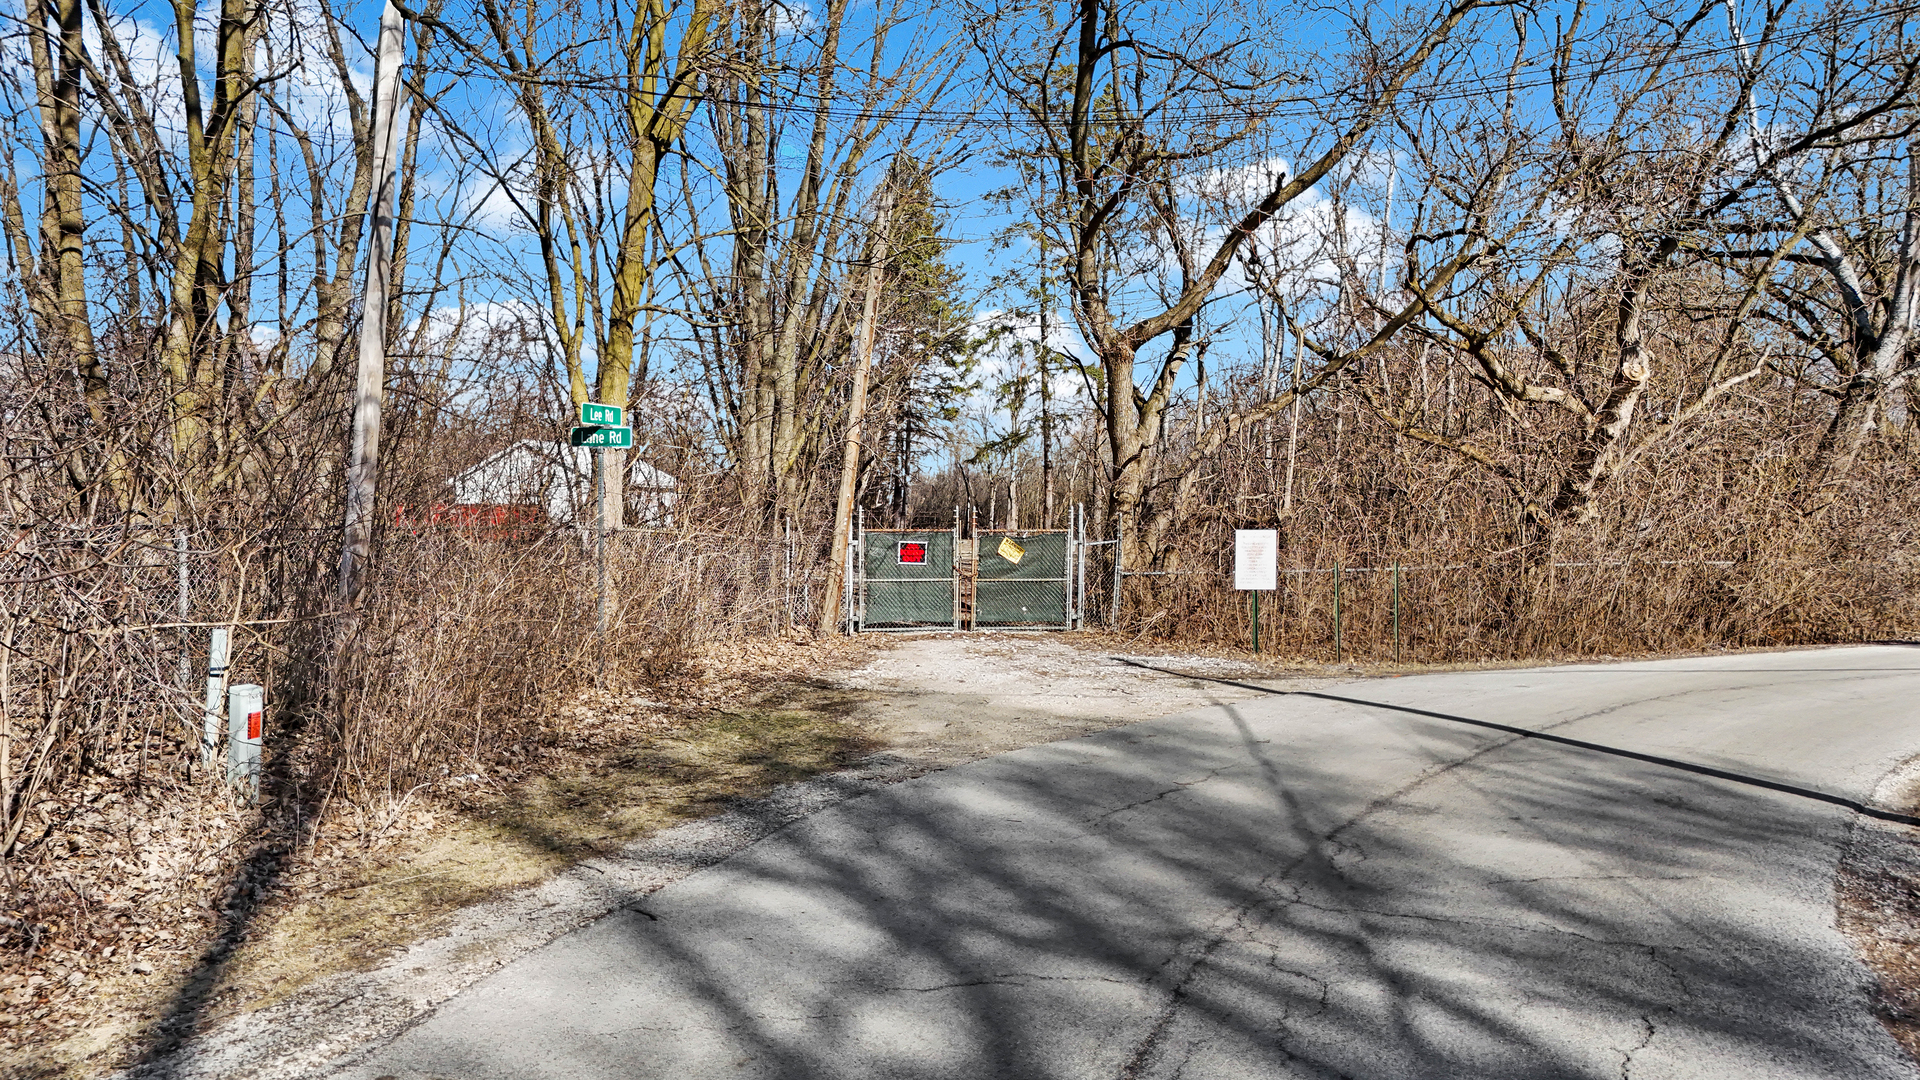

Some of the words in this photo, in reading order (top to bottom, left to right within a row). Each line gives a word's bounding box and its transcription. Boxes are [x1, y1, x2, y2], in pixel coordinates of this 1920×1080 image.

[590, 408, 602, 421] Lee
[605, 409, 613, 422] Rd
[581, 431, 604, 444] Lane
[609, 431, 622, 444] Rd
